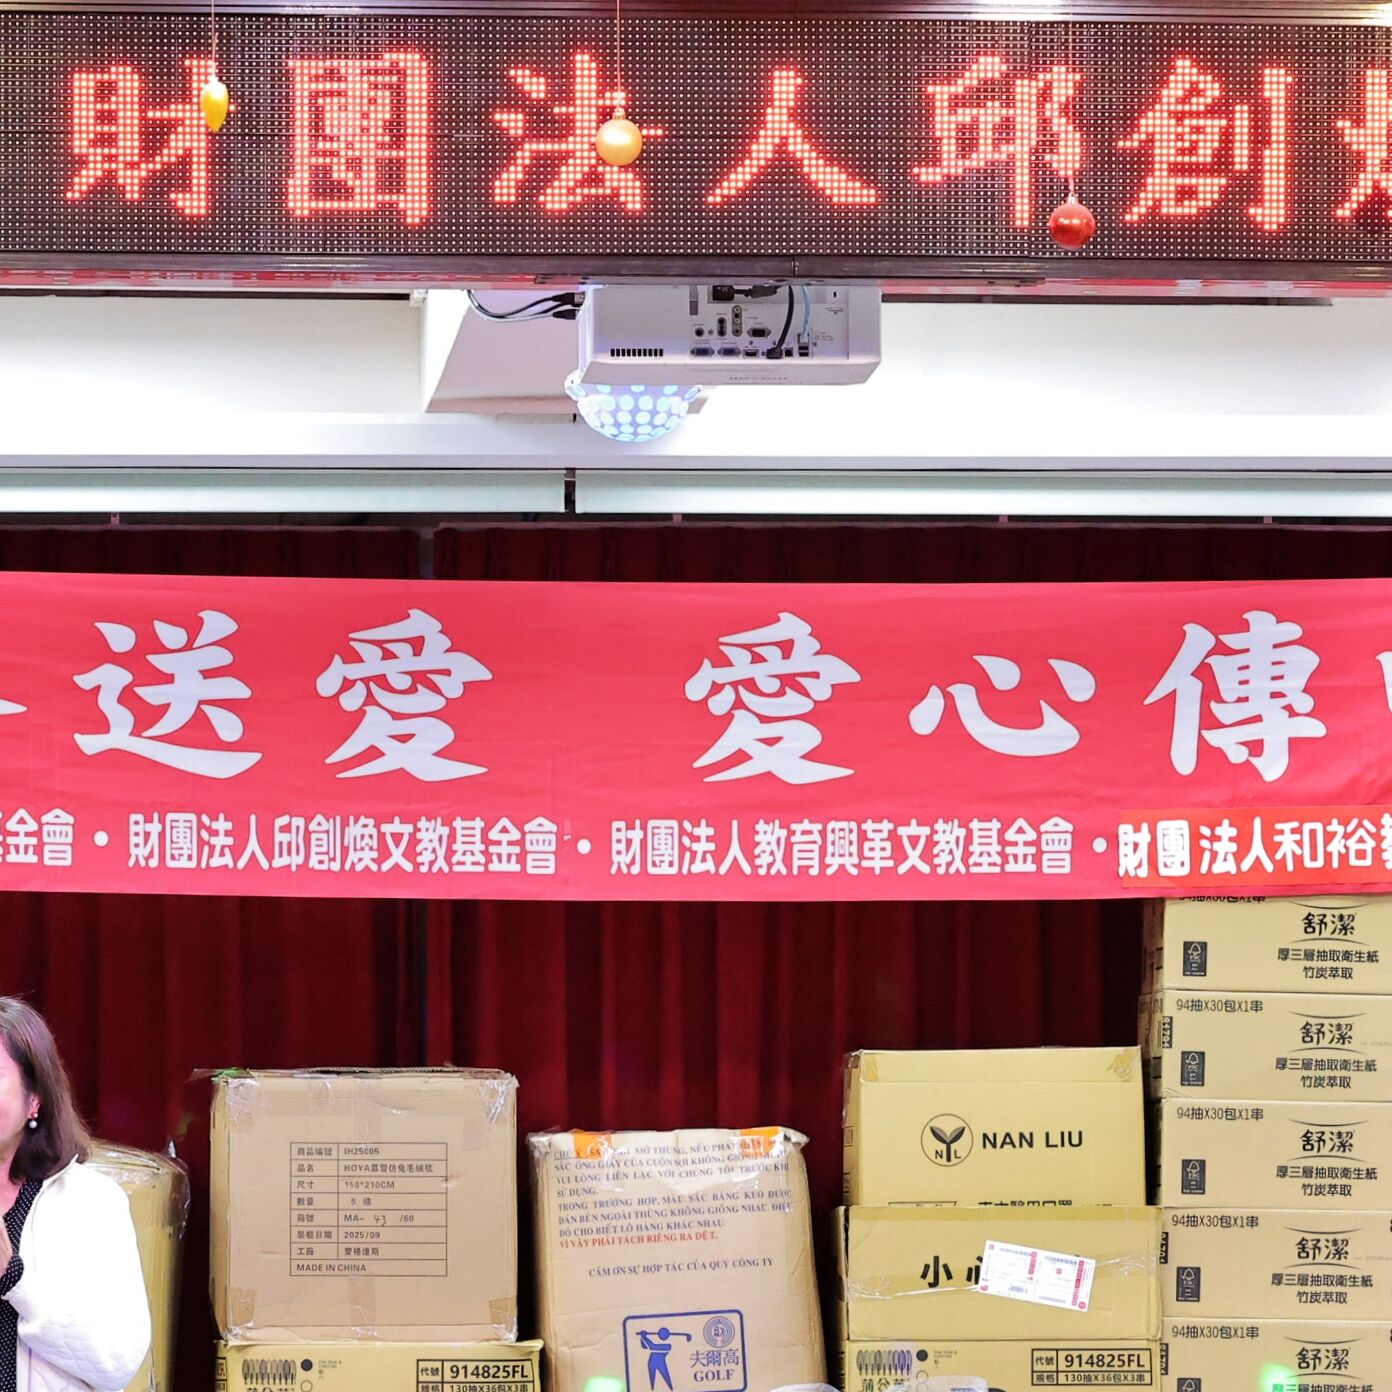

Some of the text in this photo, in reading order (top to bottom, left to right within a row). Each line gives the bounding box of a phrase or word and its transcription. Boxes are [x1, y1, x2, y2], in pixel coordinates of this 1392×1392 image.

[126, 810, 558, 875] 財團法人邱創煥文教基金會
[609, 815, 1074, 877] 財團法人教育興革文教基金會
[1302, 912, 1356, 936] 舒潔
[1278, 948, 1379, 963] 厚三層抽取衛生紙
[1303, 966, 1353, 980] 竹炭萃取
[1176, 999, 1263, 1013] 94抽X30包X1串
[1300, 1022, 1353, 1045] 舒潔
[1275, 1058, 1377, 1072] 厚三層抽取衛生紙
[1301, 1076, 1351, 1089] 竹炭萃取
[1177, 1107, 1264, 1121] 94抽X30包X1串
[982, 1131, 1084, 1149] NAN LIU
[1300, 1130, 1354, 1154] 舒潔
[1276, 1166, 1378, 1181] 厚三層抽取衛生紙
[1302, 1184, 1352, 1197] 竹炭萃取
[1172, 1214, 1259, 1229] 94抽X30包X1串
[1296, 1237, 1350, 1261] 舒潔
[762, 1257, 774, 1266] TY
[1271, 1273, 1373, 1288] 厚三層抽取衛生紙
[1296, 1291, 1348, 1304] 竹炭萃取
[1172, 1326, 1259, 1340] 94抽X30包X1串
[1034, 1354, 1145, 1369] 代號 914825FL
[1296, 1347, 1350, 1371] 舒潔
[419, 1363, 529, 1380] 代號 914825FL
[694, 1370, 734, 1383] GOLF
[1035, 1372, 1055, 1383] 規格
